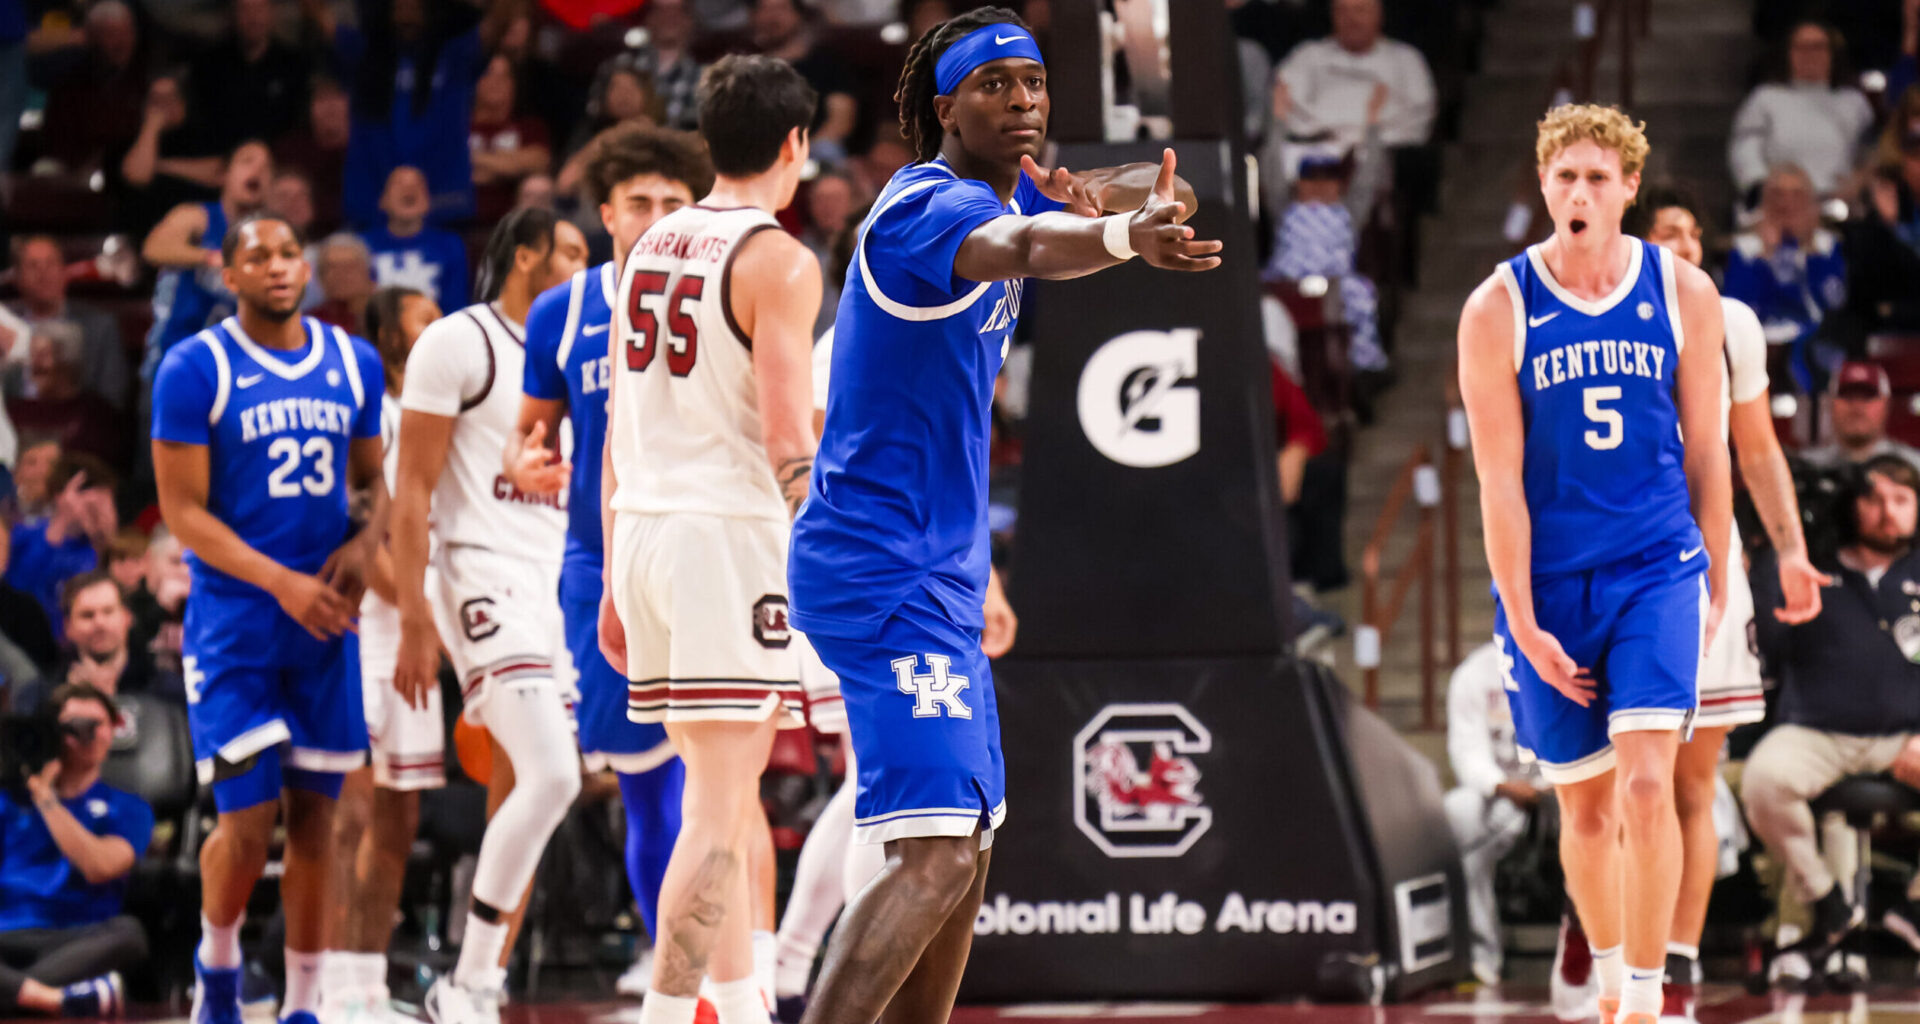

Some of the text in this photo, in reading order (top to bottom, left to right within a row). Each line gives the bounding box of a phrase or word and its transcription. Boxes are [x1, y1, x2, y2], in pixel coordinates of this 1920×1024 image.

[626, 269, 705, 378] 55
[1532, 339, 1666, 391] KENTUCKY
[240, 397, 351, 443] KENTUCKY
[1077, 328, 1203, 468] G
[1583, 385, 1624, 451] 5
[267, 436, 335, 499] 23
[890, 653, 973, 720] UK
[973, 890, 1357, 936] olonial Life Arena
